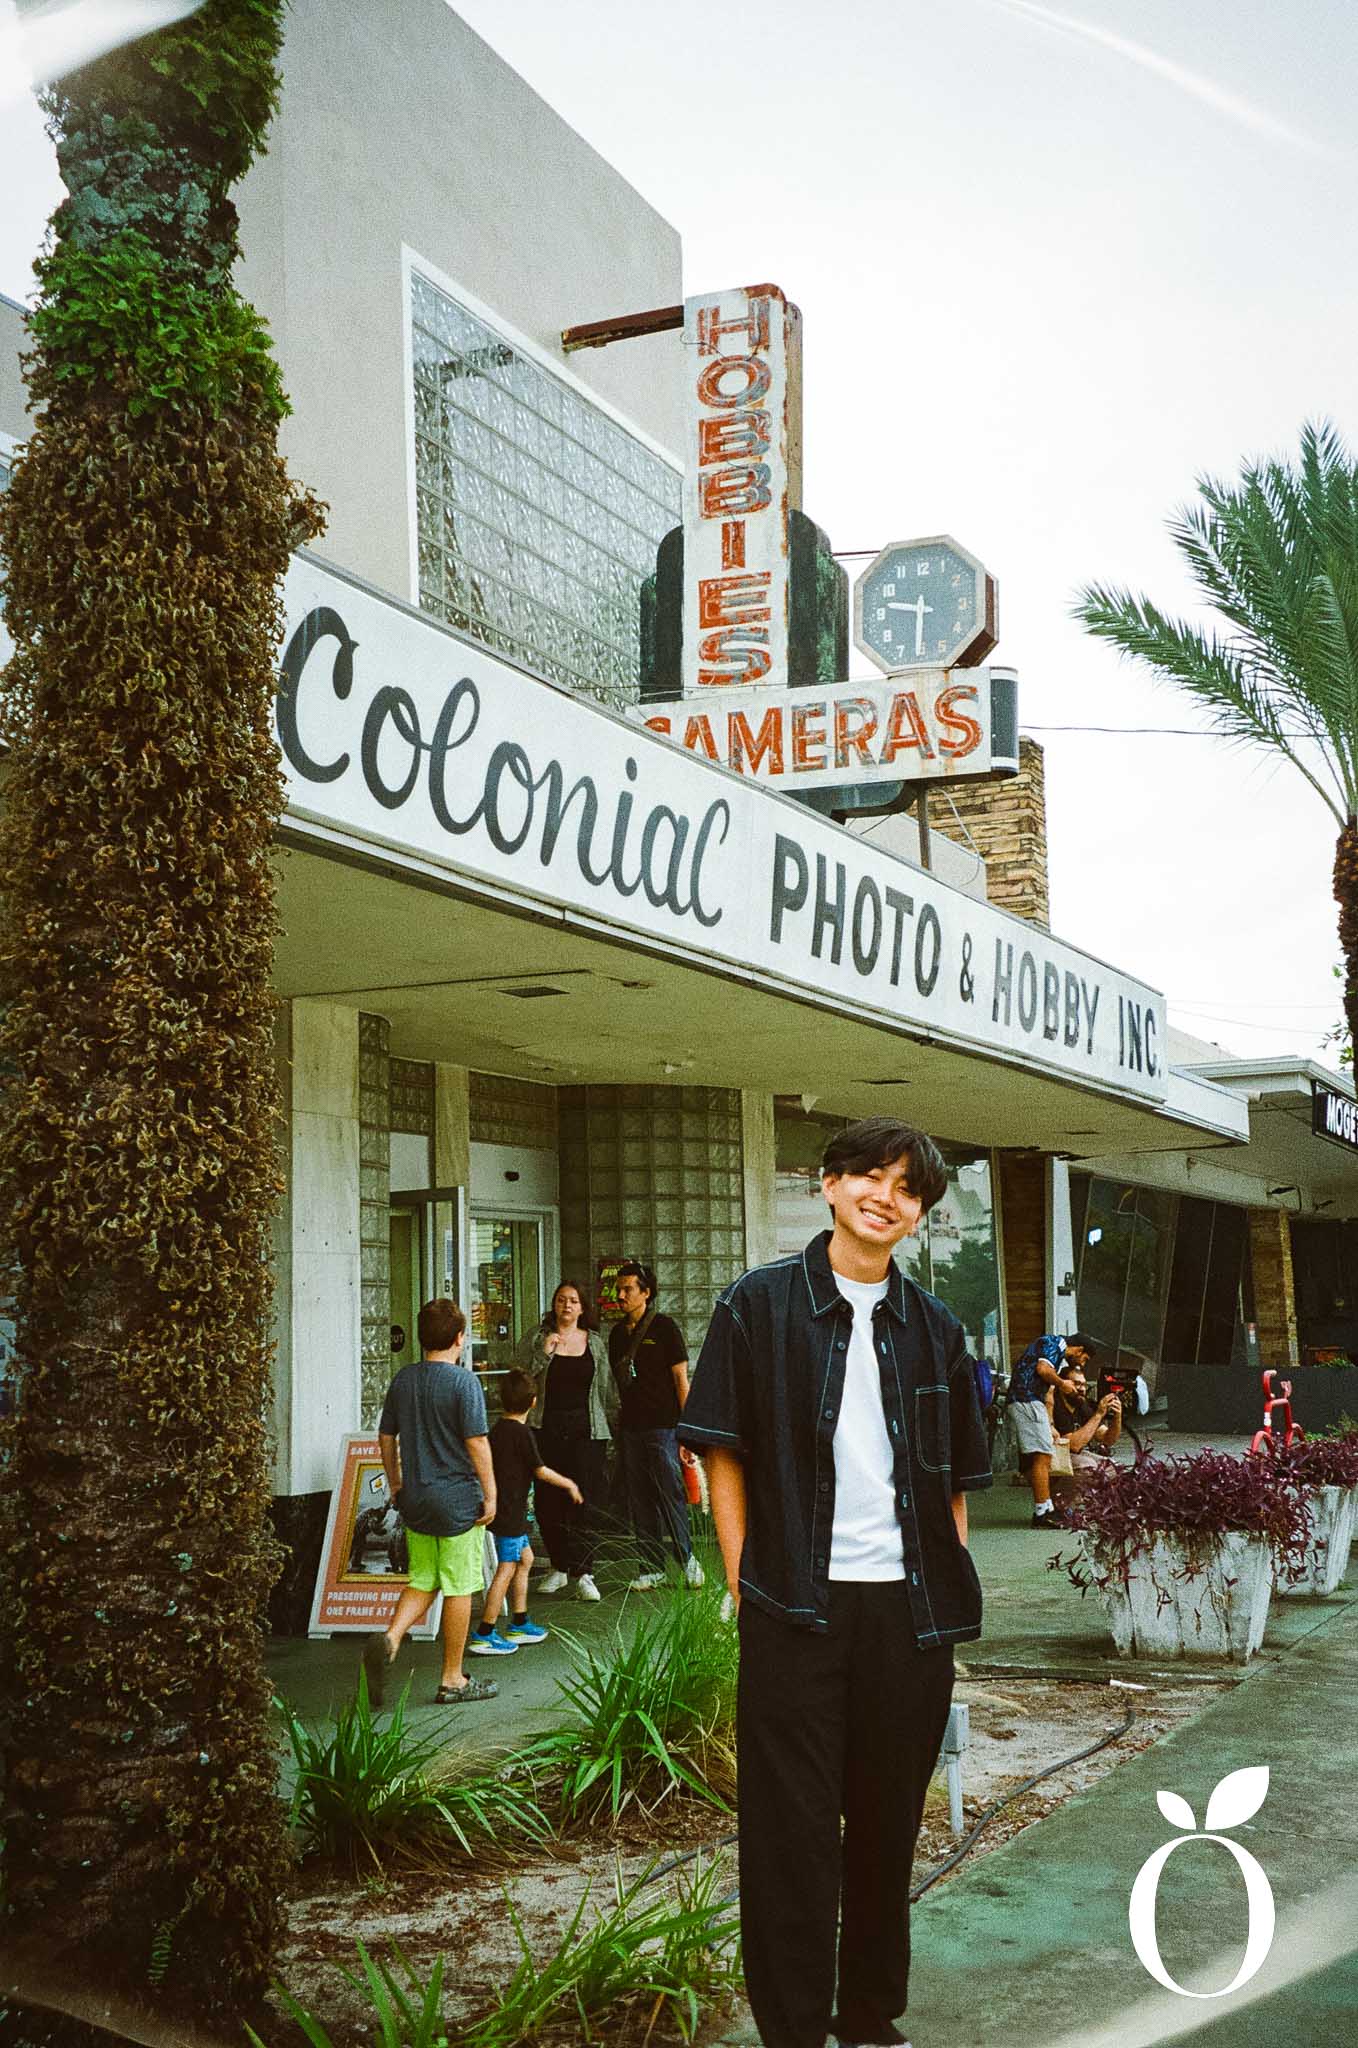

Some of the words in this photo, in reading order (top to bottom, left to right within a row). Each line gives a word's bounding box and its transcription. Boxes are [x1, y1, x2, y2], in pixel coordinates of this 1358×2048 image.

[697, 297, 772, 688] HOBBIES
[896, 565, 906, 579] 11
[917, 562, 929, 576] 12
[883, 584, 895, 598] 10
[876, 607, 886, 621] 9
[883, 630, 892, 642] 8
[896, 645, 905, 657] 7
[937, 640, 946, 653] 5
[275, 605, 730, 928] Colonial
[770, 832, 942, 998] PHOTO
[959, 932, 975, 1004] &
[991, 937, 1100, 1055] HOBBY
[1118, 995, 1162, 1079] INC.
[1326, 1093, 1358, 1145] MOGE
[327, 1591, 378, 1601] PRESERVING
[326, 1606, 343, 1616] ONE
[345, 1606, 374, 1617] FRAME
[376, 1606, 388, 1616] AT
